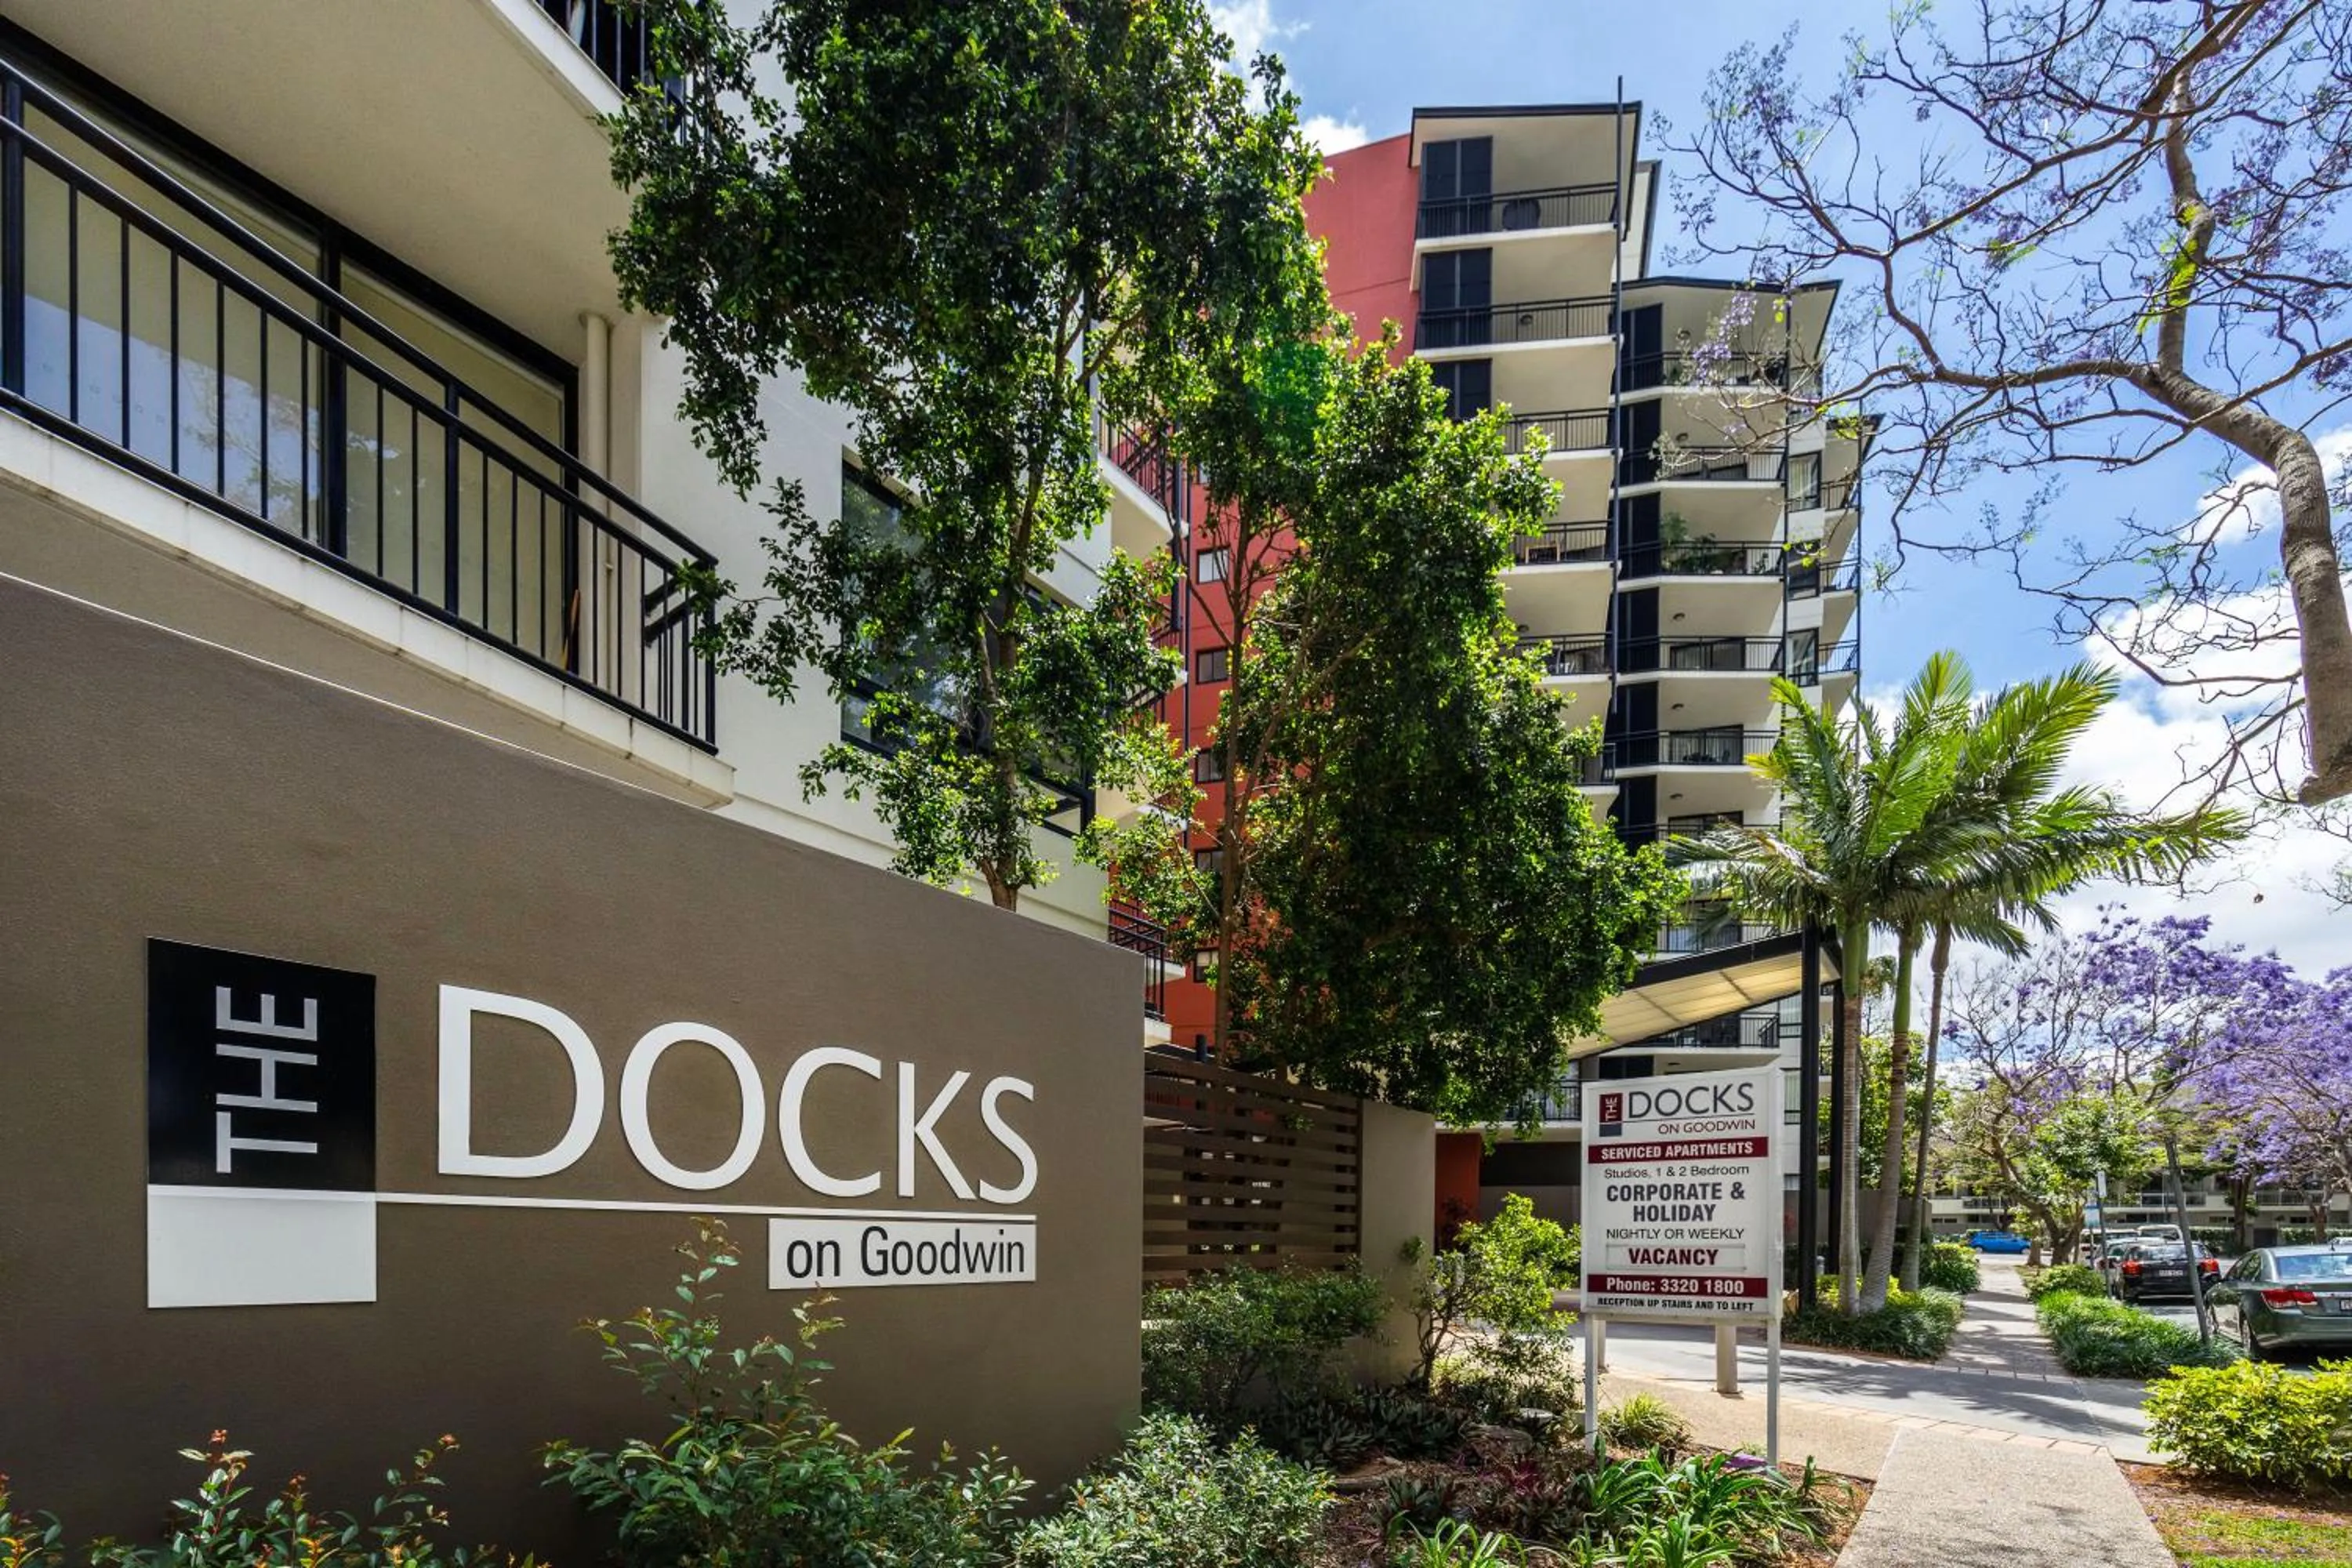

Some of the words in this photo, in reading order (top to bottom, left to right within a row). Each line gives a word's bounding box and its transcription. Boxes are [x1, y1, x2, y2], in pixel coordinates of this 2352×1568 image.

[216, 985, 318, 1174] THE
[437, 983, 1039, 1205] DOCKS
[1628, 1083, 1755, 1119] DOCKS
[1604, 1097, 1617, 1121] THE
[1658, 1123, 1680, 1134] ON
[1683, 1119, 1755, 1134] GOODWIN
[1602, 1145, 1661, 1160] SERVICED
[1665, 1142, 1753, 1158] APARTMENTS
[1657, 1167, 1661, 1177] 1
[1666, 1167, 1675, 1177] &
[1679, 1167, 1686, 1177] 2
[1690, 1164, 1749, 1176] Bedroom
[1606, 1181, 1722, 1202] CORPORATE
[1730, 1181, 1745, 1200] &
[1633, 1204, 1716, 1222] HOLIDAY
[1606, 1229, 1661, 1240] NIGHTLY
[1664, 1229, 1684, 1240] OR
[1688, 1229, 1744, 1240] WEEKLY
[786, 1238, 841, 1279] on
[860, 1226, 1026, 1278] Goodwin
[1628, 1248, 1719, 1265] VACANCY
[1606, 1277, 1656, 1292] Phone:
[1660, 1279, 1699, 1293] 3320
[1704, 1279, 1744, 1294] 1800
[1597, 1298, 1644, 1307] RECEPTION
[1647, 1299, 1660, 1308] UP
[1661, 1299, 1693, 1308] STAIRS
[1694, 1301, 1715, 1309] AND
[1716, 1301, 1728, 1310] TO
[1730, 1302, 1755, 1312] LEFT
